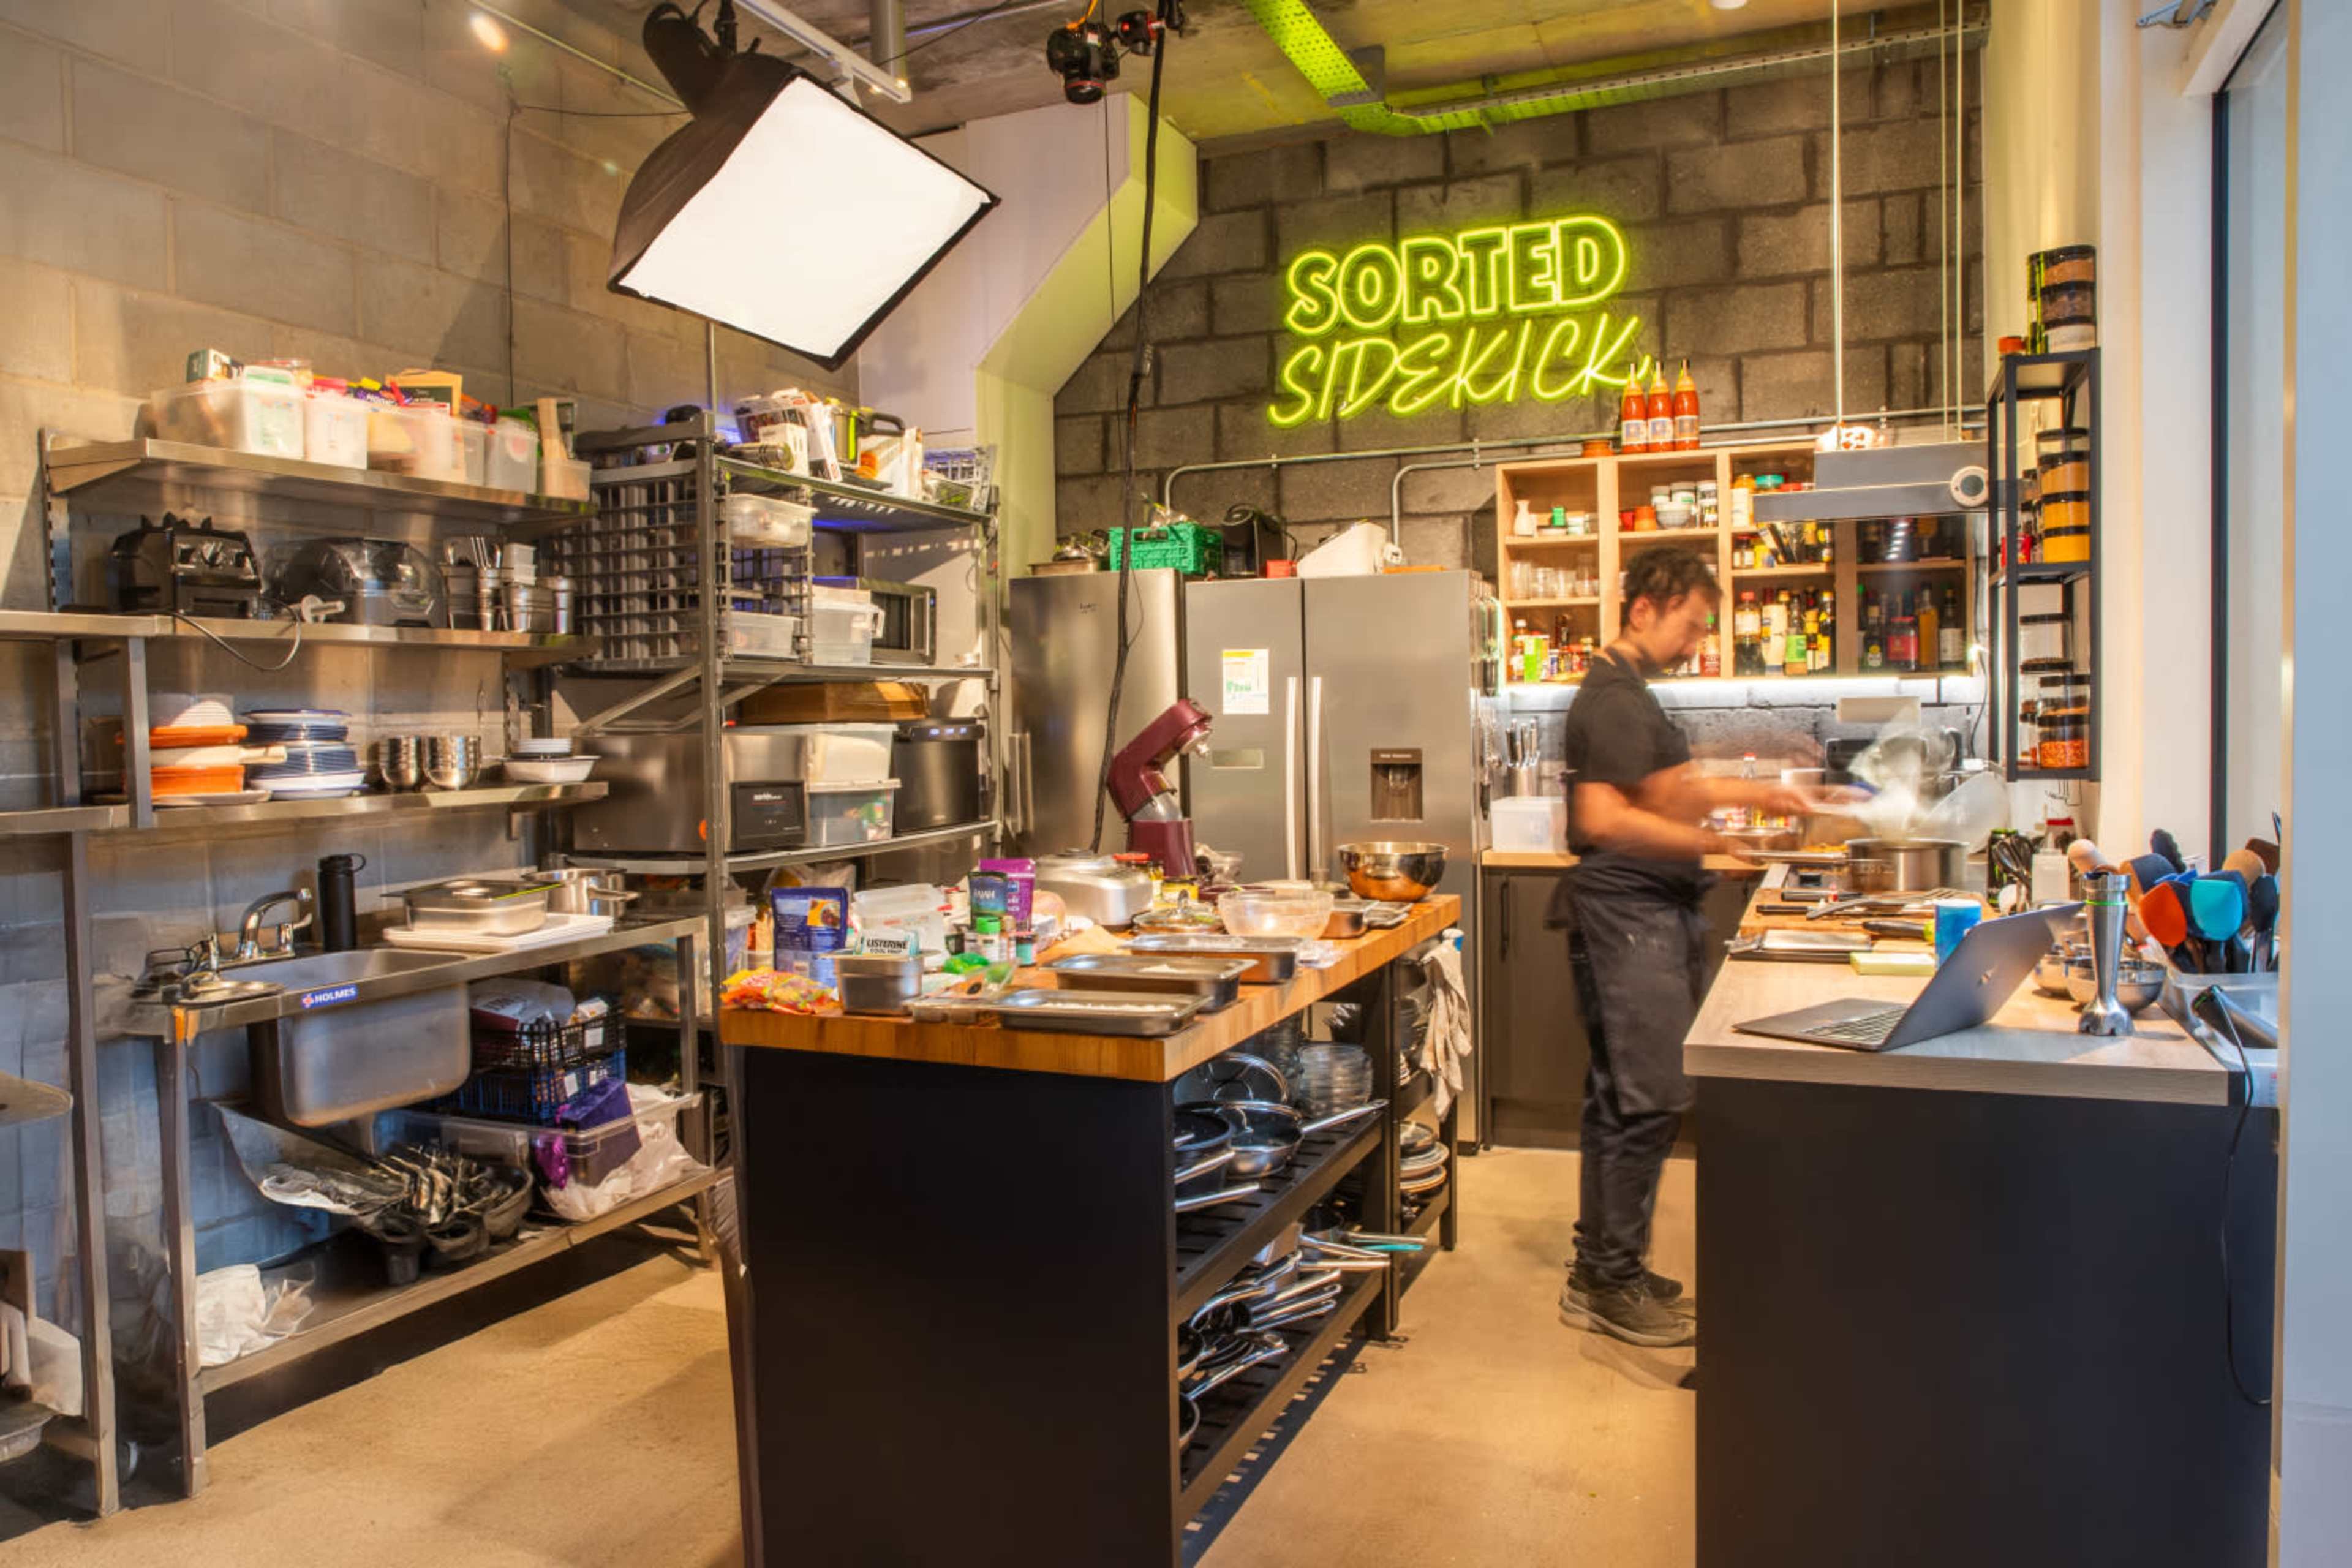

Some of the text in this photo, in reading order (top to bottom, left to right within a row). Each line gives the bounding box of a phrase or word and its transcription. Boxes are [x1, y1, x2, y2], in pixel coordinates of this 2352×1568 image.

[1285, 214, 1626, 335] SORTED
[1266, 311, 1653, 426] SIDEKICK
[867, 938, 908, 949] LISTERINE
[314, 987, 356, 1003] HOLMES
